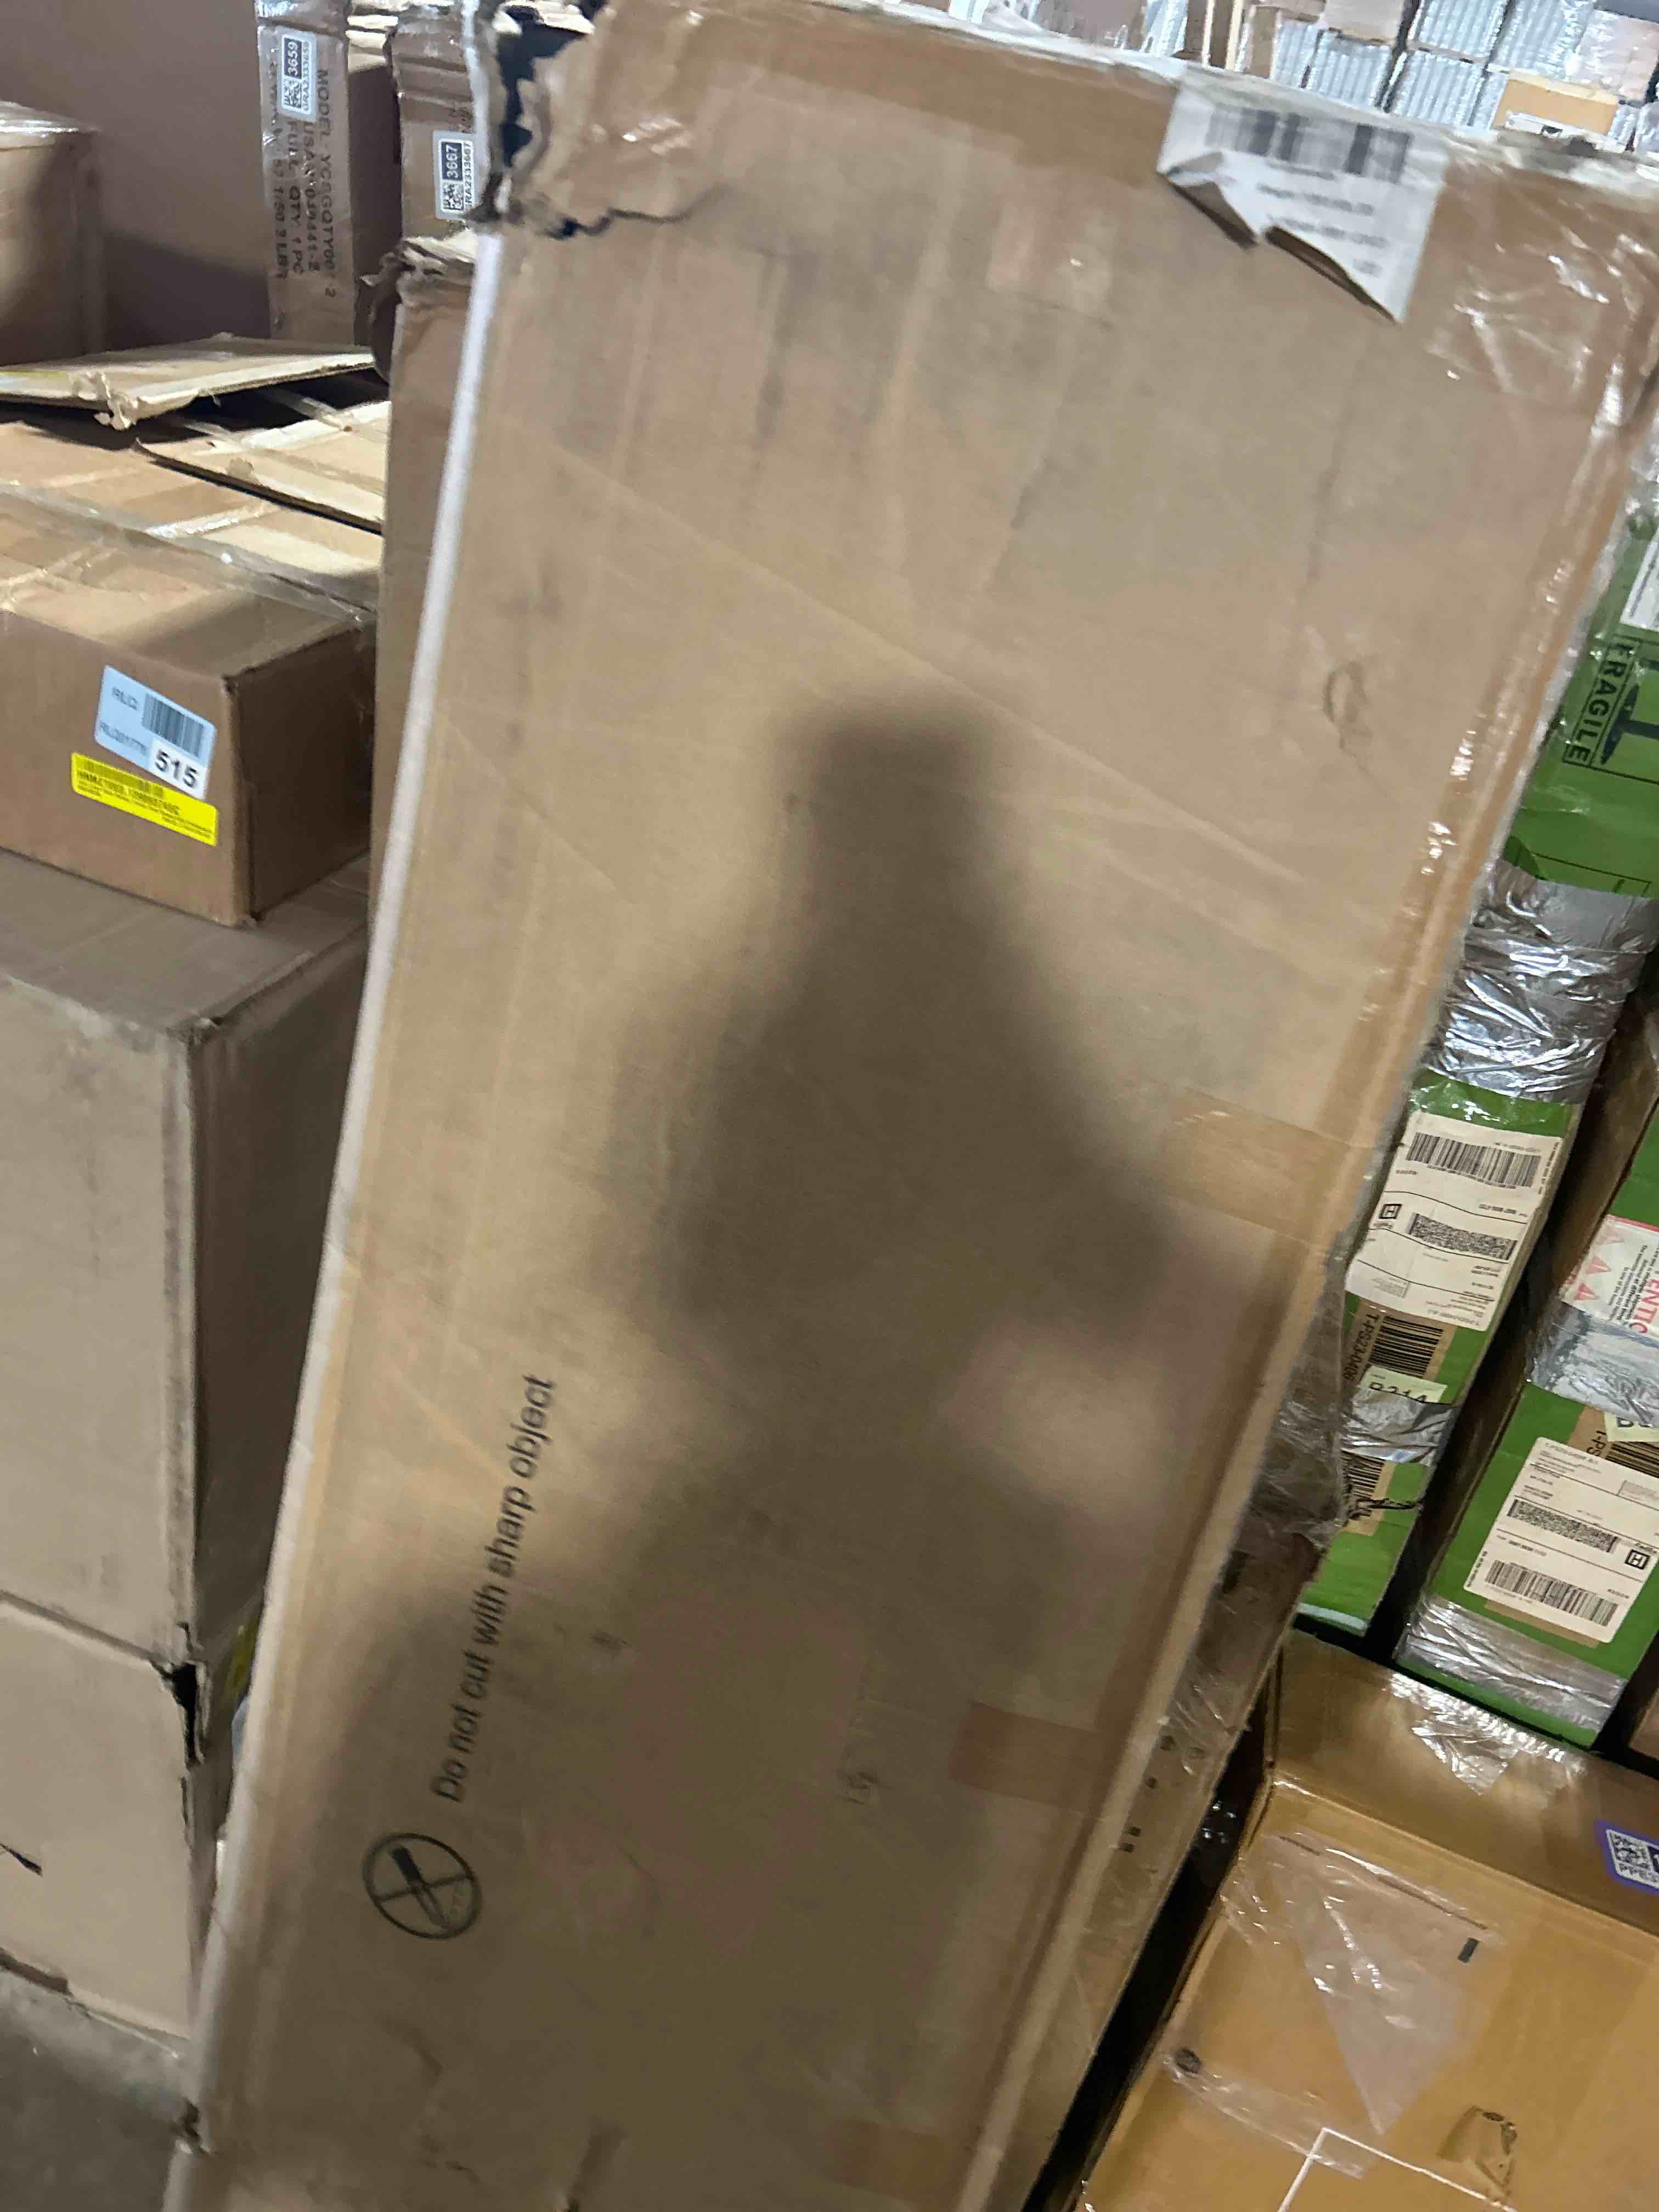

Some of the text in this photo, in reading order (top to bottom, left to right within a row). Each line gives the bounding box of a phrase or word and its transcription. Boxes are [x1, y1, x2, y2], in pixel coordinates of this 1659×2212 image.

[287, 41, 299, 76] 3659
[446, 144, 459, 179] 3667
[1566, 640, 1634, 763] FRAGILE
[155, 749, 199, 789] 515
[431, 1373, 556, 1804] Do not cut with sharp object
